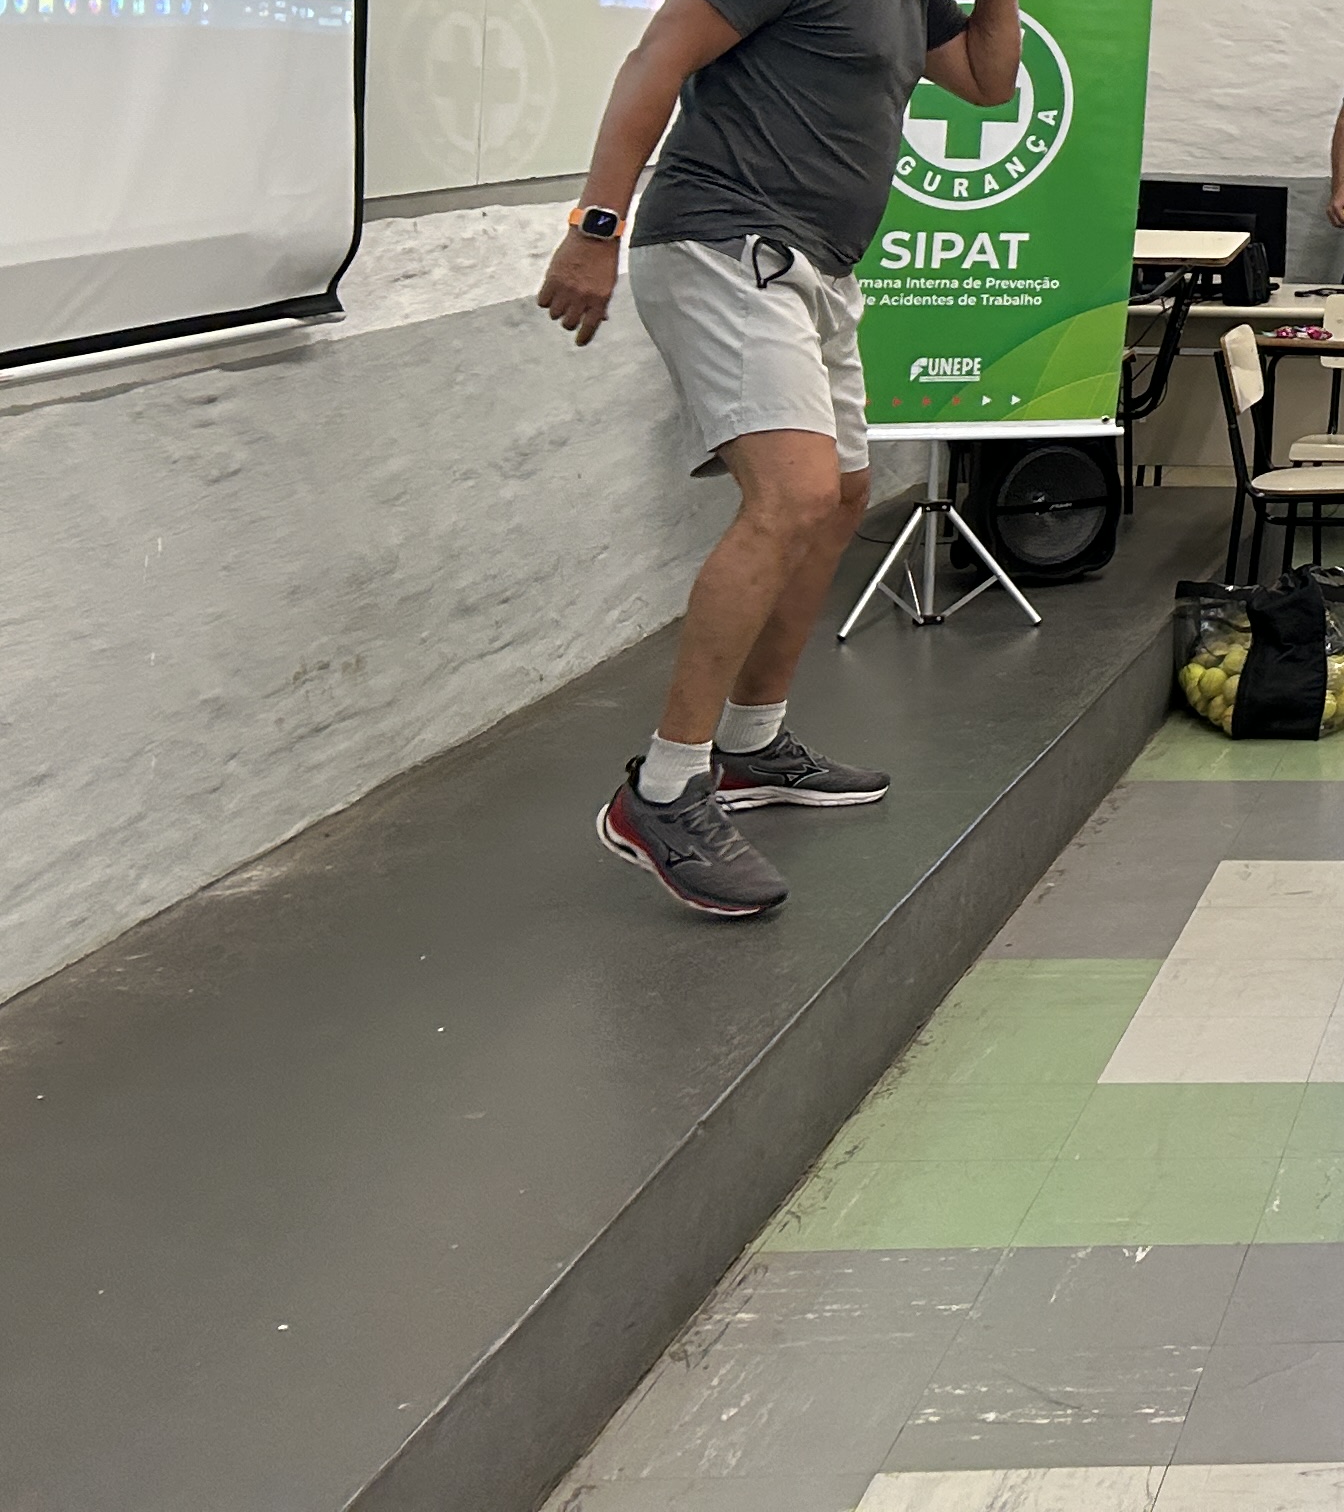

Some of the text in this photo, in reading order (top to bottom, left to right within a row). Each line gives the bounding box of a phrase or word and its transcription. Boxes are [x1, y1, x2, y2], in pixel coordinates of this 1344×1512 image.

[879, 230, 1030, 270] SIPAT
[906, 277, 959, 289] Interna
[962, 277, 981, 289] de
[986, 276, 1060, 292] Prevenção
[879, 293, 954, 306] Acidentes
[958, 293, 976, 306] de
[980, 293, 1042, 306] Trabalho
